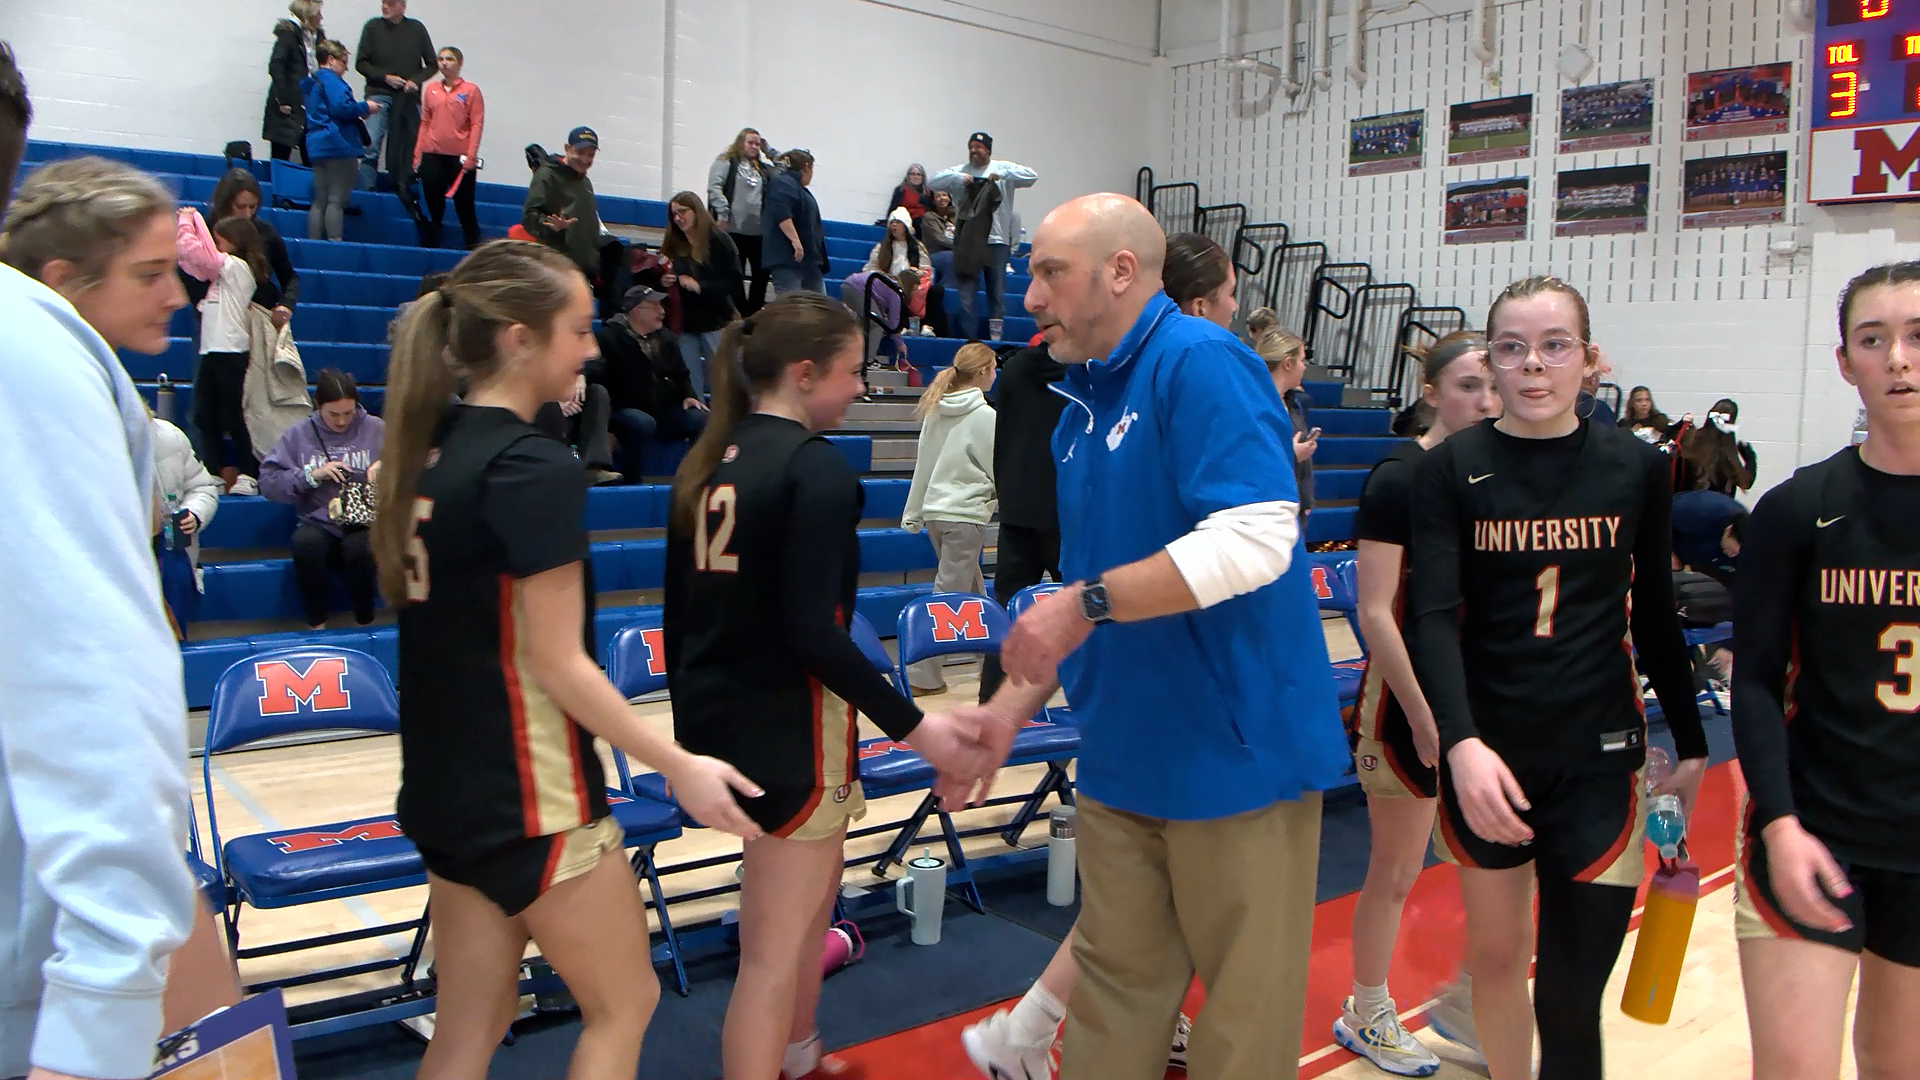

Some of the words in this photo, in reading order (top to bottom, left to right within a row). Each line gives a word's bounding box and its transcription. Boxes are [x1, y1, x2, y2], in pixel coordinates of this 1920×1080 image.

[1827, 44, 1859, 65] TOL
[1829, 70, 1858, 118] 3
[1852, 123, 1920, 195] M
[694, 484, 739, 573] 12
[1474, 515, 1621, 552] UNIVERSITY
[926, 600, 990, 643] M
[1534, 565, 1560, 637] 1
[255, 656, 351, 717] M
[1874, 621, 1920, 713] 3
[267, 819, 404, 855] M
